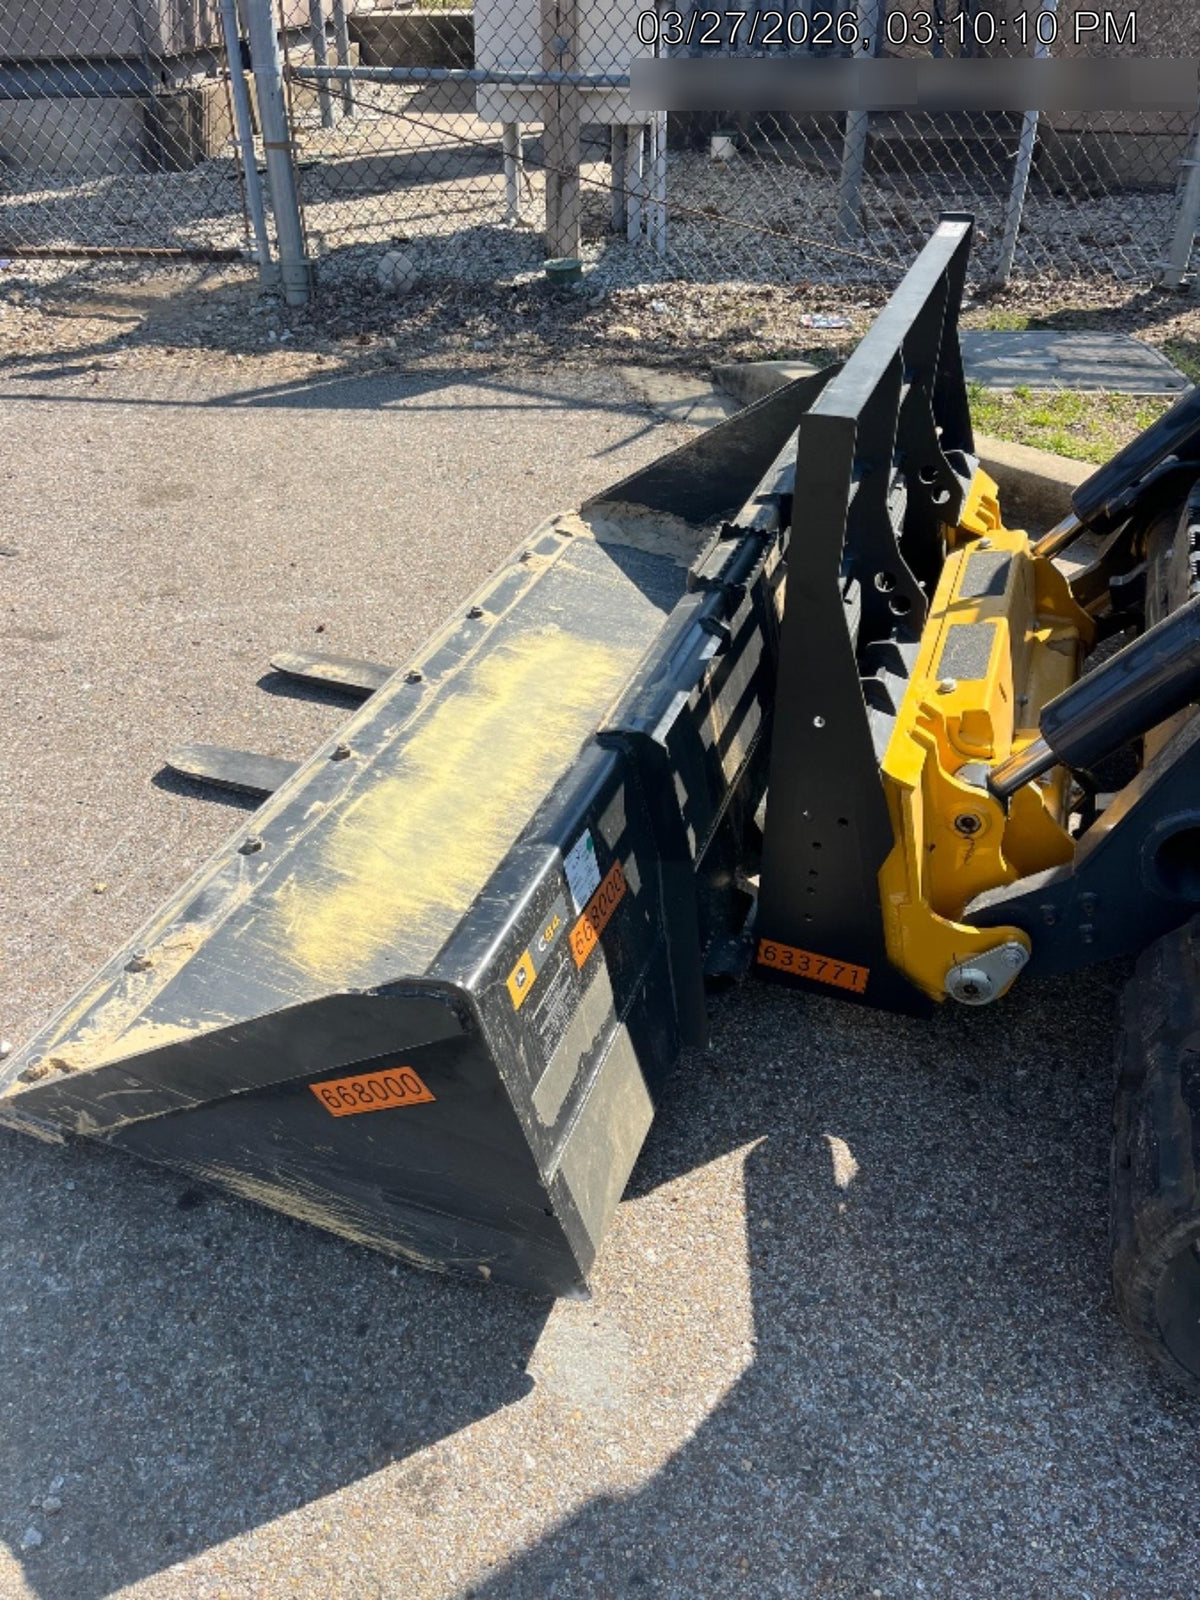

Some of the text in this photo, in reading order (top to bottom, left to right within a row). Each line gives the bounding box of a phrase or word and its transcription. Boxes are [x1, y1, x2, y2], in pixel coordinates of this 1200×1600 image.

[575, 868, 622, 955] 668000
[763, 945, 859, 986] 633771
[321, 1072, 423, 1109] 668000
